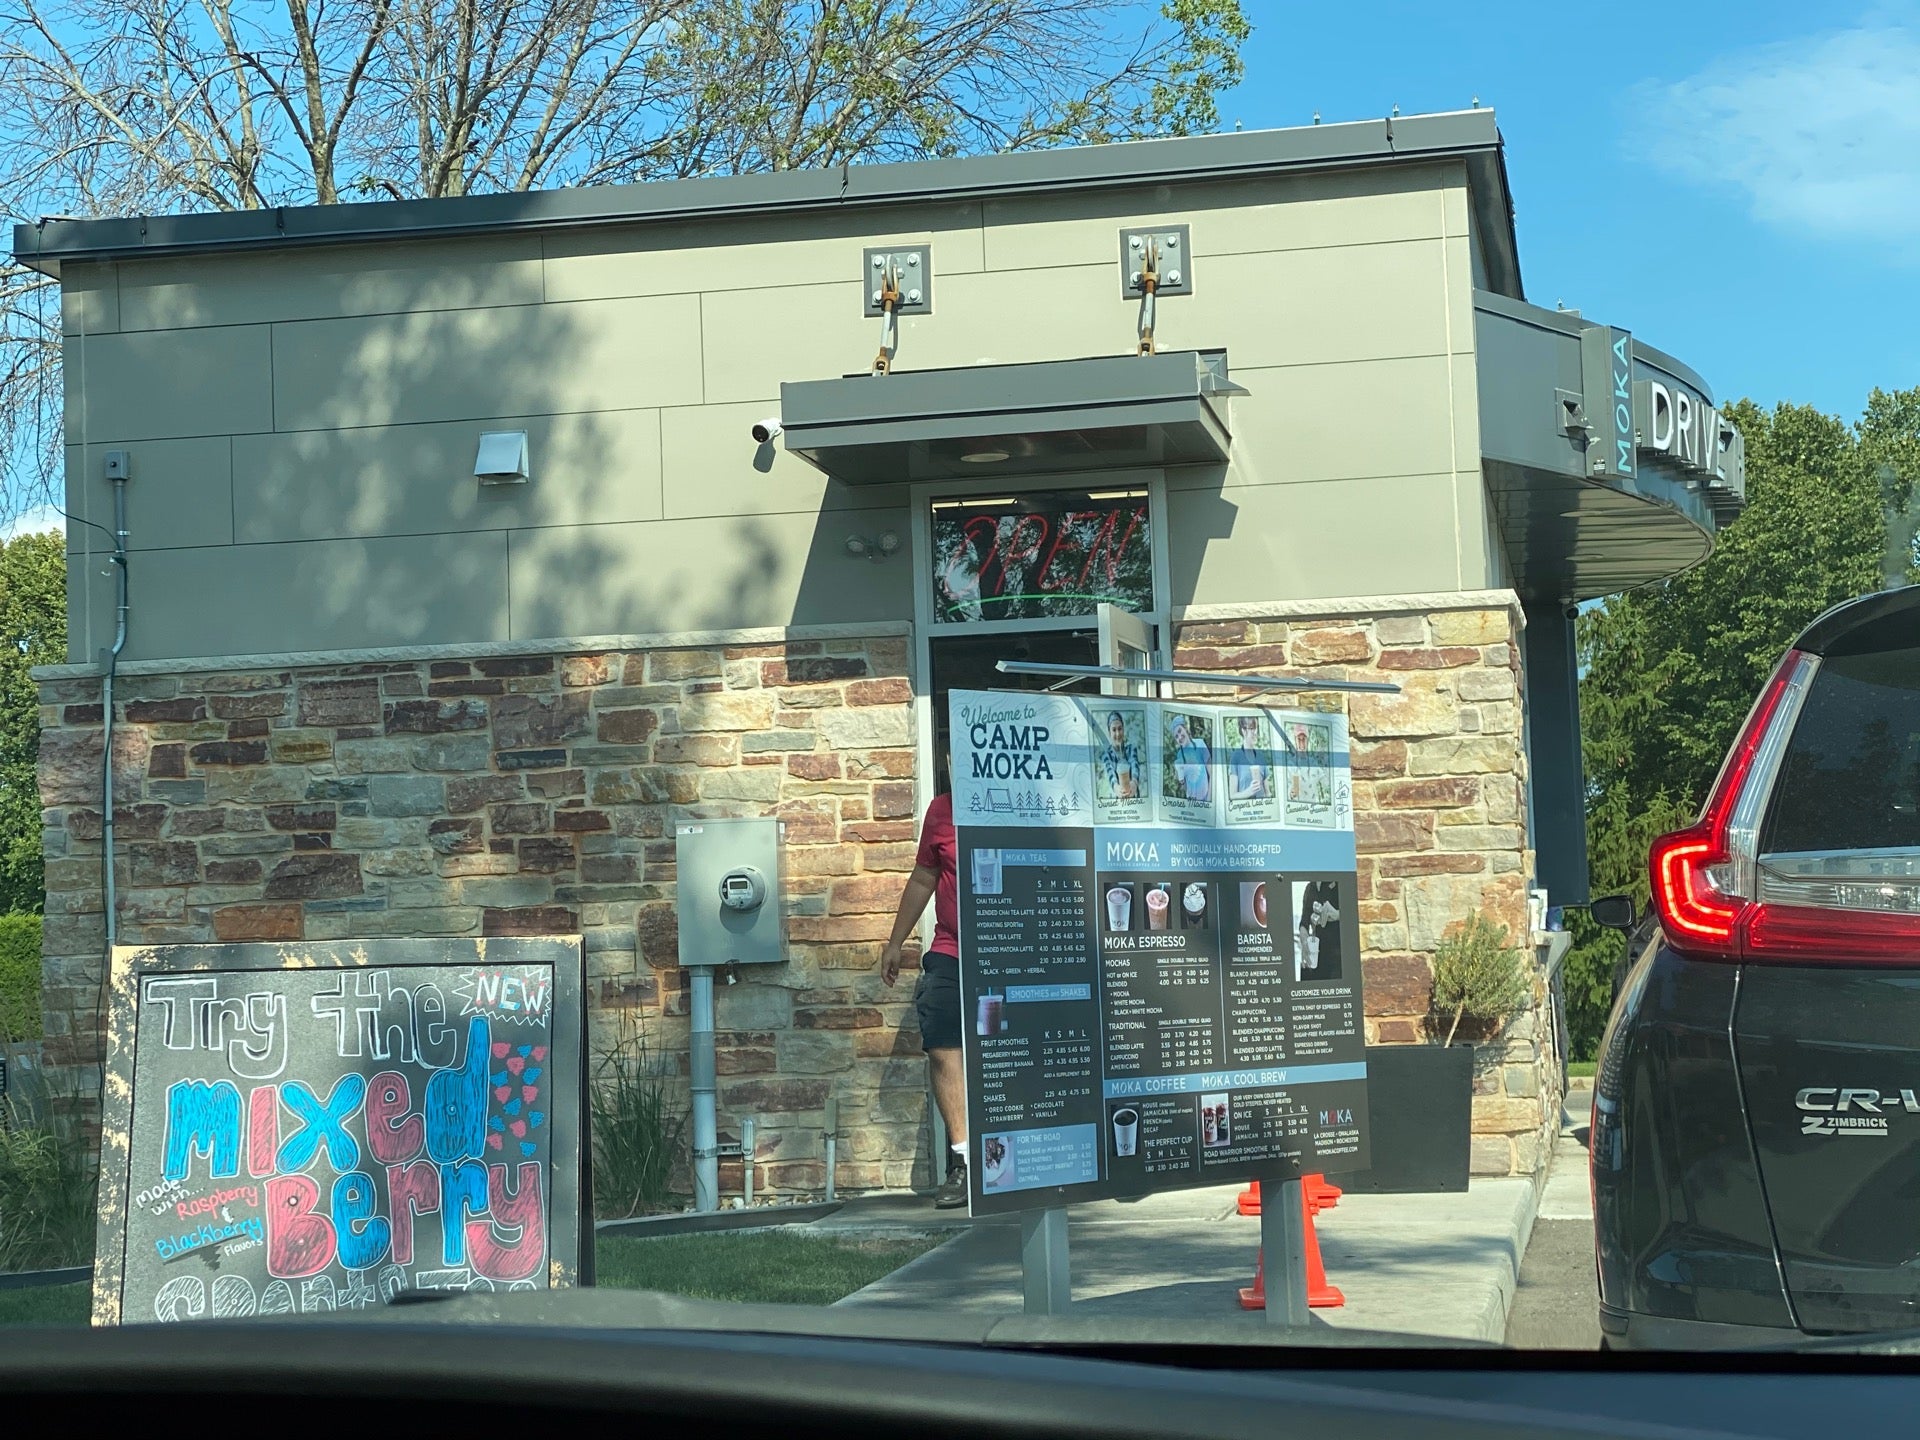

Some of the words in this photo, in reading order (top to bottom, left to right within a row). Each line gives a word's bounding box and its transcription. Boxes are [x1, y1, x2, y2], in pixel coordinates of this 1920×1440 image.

[1613, 336, 1632, 472] MOKA
[944, 507, 1146, 599] OPEN
[962, 705, 1021, 726] Welcome
[1024, 705, 1036, 719] to
[971, 723, 1049, 750] CAMP
[972, 752, 1053, 779] MOKA
[1107, 842, 1159, 862] MOKA
[1171, 844, 1221, 854] INDIVIDUALLY
[1224, 844, 1281, 854] HAND-CRAFTED
[1006, 854, 1026, 862] MOKA
[1030, 854, 1047, 862] TEAS
[1171, 858, 1181, 867] BY
[1184, 857, 1205, 867] YOUR
[1207, 857, 1228, 867] MOKA
[1230, 857, 1265, 867] BARISTAS
[1105, 937, 1135, 949] MOKA
[1139, 936, 1185, 947] ESPRESSO
[1237, 934, 1272, 944] BARISTA
[1106, 959, 1130, 967] MOCHAS
[474, 973, 544, 1015] NEW
[1011, 990, 1049, 999] SMOOTHIES
[1060, 989, 1086, 997] SHAKES
[1291, 989, 1320, 997] CUSTOMIZE
[144, 976, 288, 1079] Try
[311, 971, 458, 1069] the
[1109, 1022, 1146, 1030] TRADITIONAL
[1045, 1031, 1050, 1039] K
[998, 1038, 1028, 1046] SMOOTHIES
[982, 1051, 1010, 1059] MEGABERRY
[1111, 1053, 1138, 1061] CAPPUCCINO
[983, 1062, 1013, 1070] STRAWBERRY
[1112, 1079, 1142, 1093] MOKA
[1145, 1077, 1186, 1090] COFFEE
[1202, 1074, 1231, 1087] MOKA
[1234, 1072, 1259, 1085] COOL
[1261, 1071, 1286, 1083] BREW
[1034, 1101, 1065, 1109] CHOCOLATE
[989, 1114, 1023, 1123] STRAWBERRY
[1234, 1111, 1242, 1119] ON
[1244, 1110, 1252, 1118] ICE
[1266, 1108, 1269, 1116] S
[1320, 1109, 1352, 1124] MOKA
[1827, 1118, 1888, 1127] ZIMBRICK
[1017, 1136, 1029, 1144] FOR
[1030, 1135, 1042, 1143] THE
[1044, 1133, 1060, 1142] ROAD
[1235, 1132, 1259, 1140] JAMAICAN
[1144, 1140, 1155, 1148] THE
[1156, 1138, 1181, 1147] PERFECT
[1182, 1136, 1193, 1145] CUP
[1147, 1151, 1151, 1159] S
[1158, 1150, 1163, 1158] M
[1170, 1149, 1174, 1157] L
[1180, 1148, 1188, 1156] XL
[1204, 1150, 1218, 1158] ROAD
[1219, 1147, 1241, 1156] WARRIOR
[1242, 1145, 1268, 1153] SMOOTHIE
[136, 1176, 181, 1208] made
[177, 1186, 258, 1220] Raspberry
[263, 1160, 545, 1280] Berry
[156, 1217, 263, 1258] Blackberry
[224, 1239, 263, 1256] Flavors
